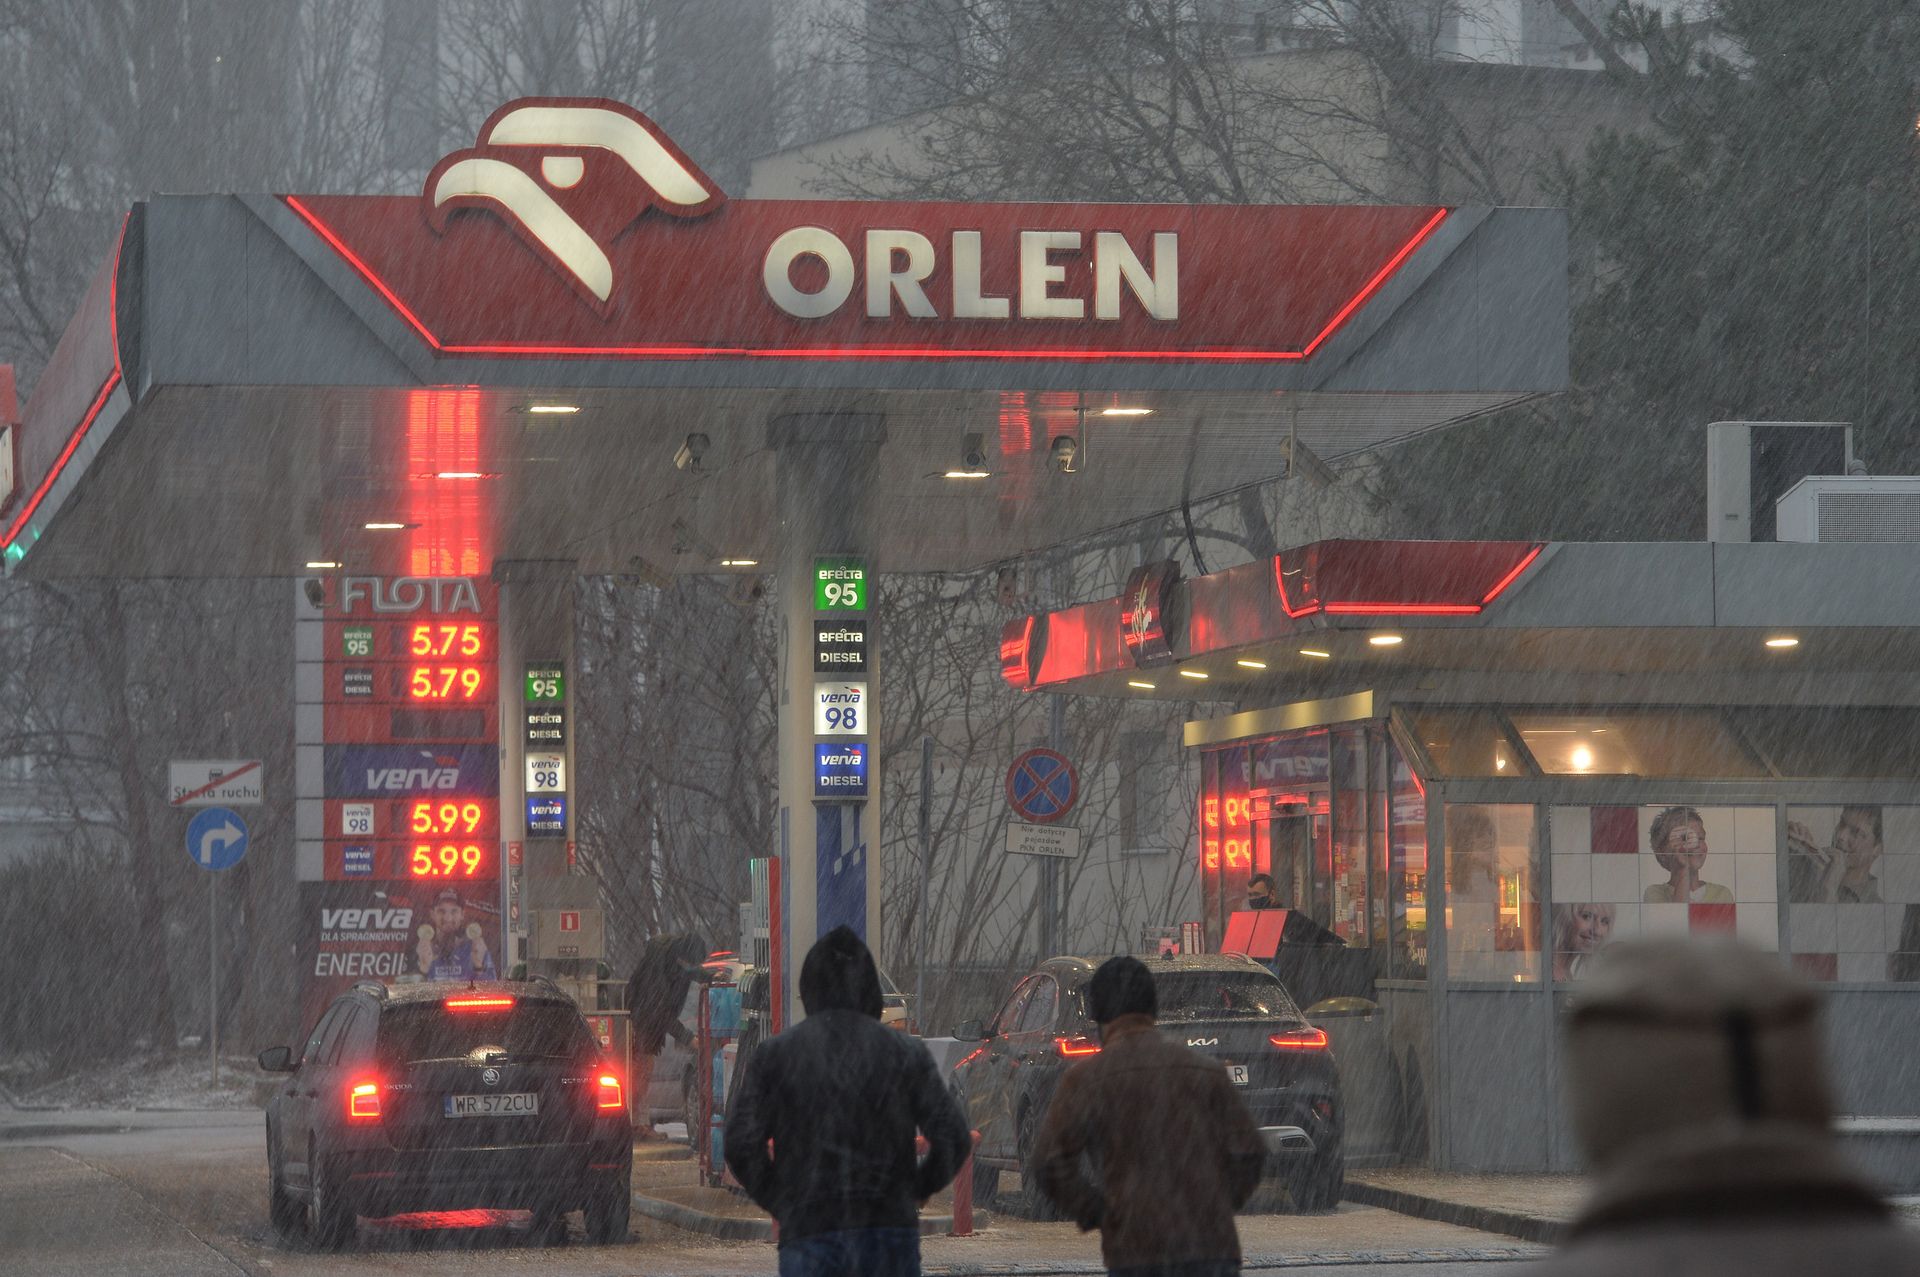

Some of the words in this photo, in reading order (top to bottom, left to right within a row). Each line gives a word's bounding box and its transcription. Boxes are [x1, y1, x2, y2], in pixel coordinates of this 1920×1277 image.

[763, 226, 1180, 321] ORLEN
[818, 566, 863, 580] efecta
[341, 576, 482, 614] FLOTA
[824, 583, 858, 607] 95
[411, 625, 481, 657] 5.75
[818, 628, 863, 643] efecta
[347, 640, 369, 656] 95
[820, 652, 863, 663] DIESEL
[411, 667, 481, 698] 5.79
[532, 680, 558, 698] 95
[345, 686, 372, 694] DIESEL
[820, 693, 861, 703] verva
[528, 712, 562, 725] efecta
[825, 707, 857, 730] 98
[529, 730, 562, 739] DIESEL
[531, 761, 561, 769] verva
[820, 754, 862, 766] verva
[366, 768, 460, 790] verva
[534, 772, 558, 789] 98
[820, 776, 863, 787] DIESEL
[222, 786, 260, 799] ruchu
[531, 805, 562, 816] verva
[349, 818, 369, 832] 98
[411, 803, 482, 833] 5.99
[530, 821, 563, 830] DIESEL
[345, 851, 371, 860] verva
[1039, 846, 1065, 855] ORLEN
[411, 844, 482, 876] 5.99
[345, 864, 372, 872] DIESEL
[321, 908, 414, 930] verva
[320, 932, 339, 942] DLA
[314, 952, 405, 977] ENERGII
[1187, 1037, 1218, 1047] KIA
[455, 1097, 477, 1113] WR
[483, 1094, 534, 1112] 572CU
